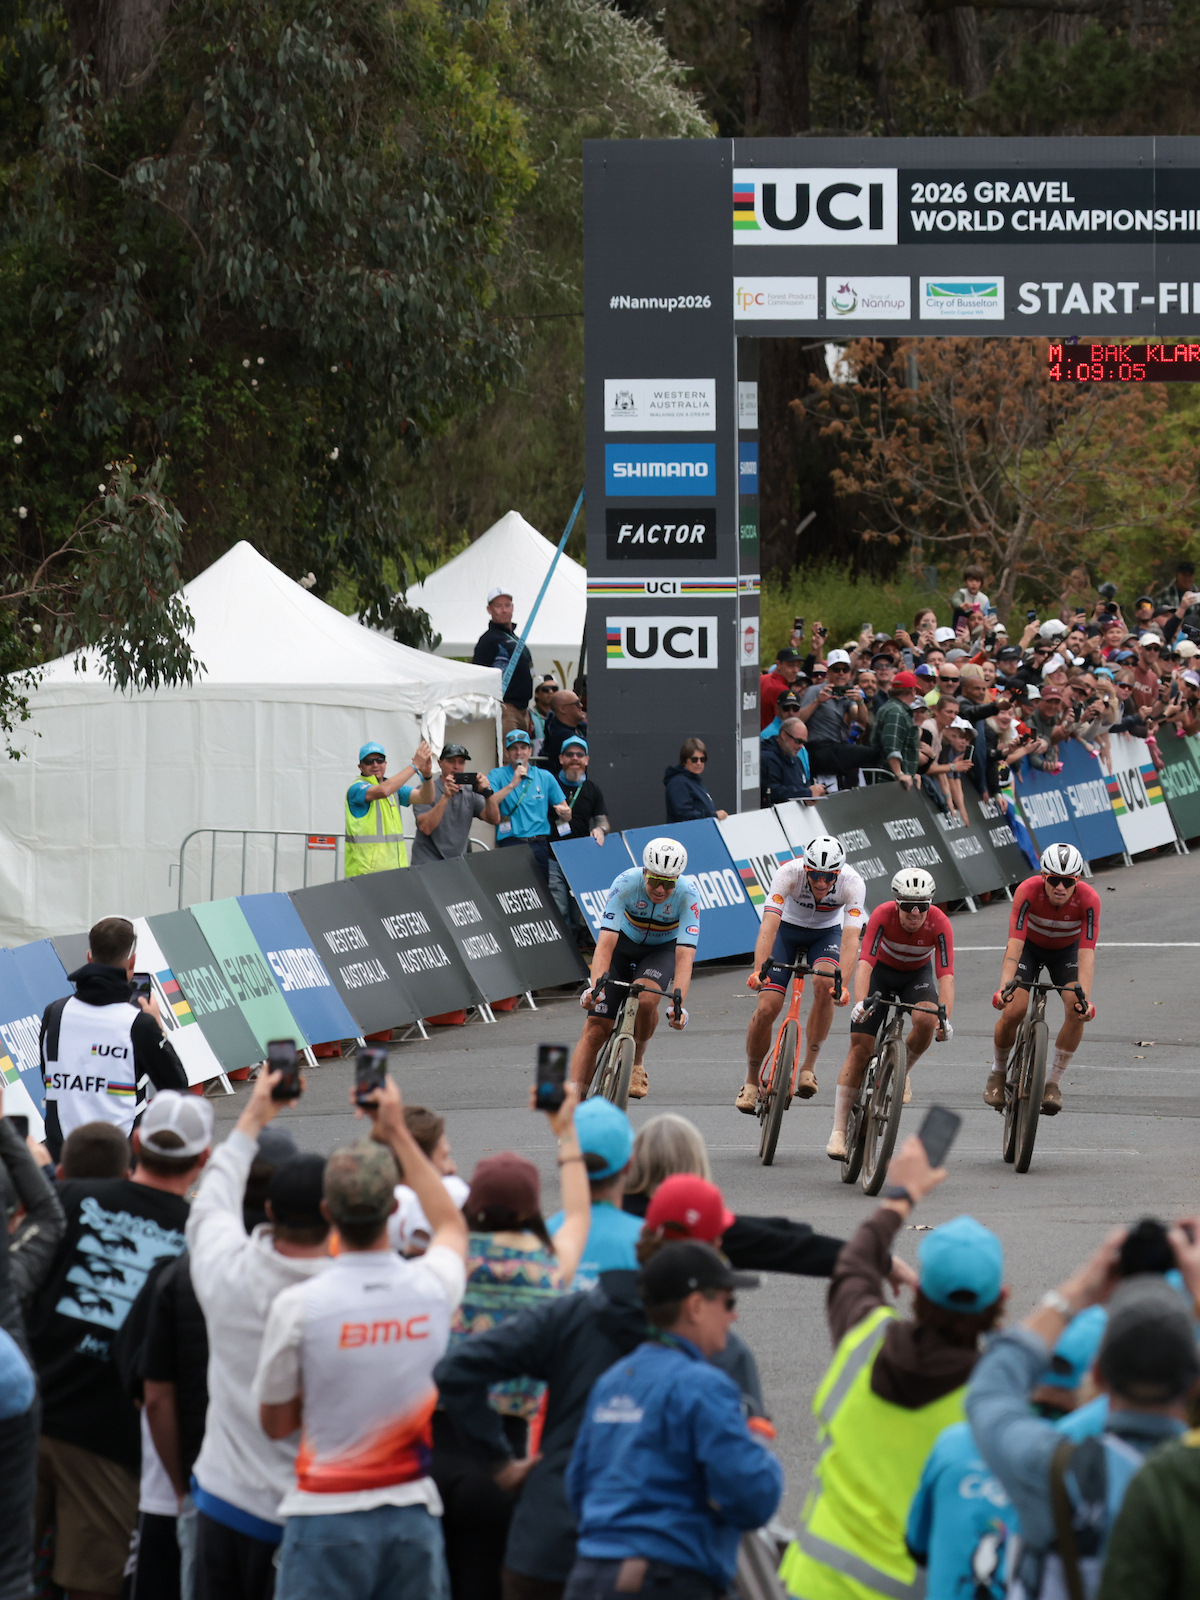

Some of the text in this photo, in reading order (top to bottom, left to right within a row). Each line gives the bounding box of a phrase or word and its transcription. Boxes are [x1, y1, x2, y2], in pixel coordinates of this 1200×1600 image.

[911, 181, 1075, 204] 2026 GRAVEL
[761, 182, 884, 232] UCI
[911, 210, 1004, 232] WORLD
[610, 296, 712, 312] #Nannup2026
[736, 286, 764, 312] fpc
[862, 298, 905, 310] Nannup
[926, 298, 998, 308] City of Busselton
[1091, 345, 1132, 362] BAK
[1049, 363, 1146, 381] 4:09:05
[613, 462, 708, 478] SHIMANO
[617, 524, 706, 544] FACTOR
[647, 582, 676, 594] UCI
[626, 626, 708, 659] UCI
[1066, 778, 1112, 818] SHIMANO
[1116, 767, 1149, 813] UCI
[1020, 789, 1069, 830] SHIMANO
[883, 818, 926, 842] WESTERN
[896, 845, 943, 868] AUSTRALIA
[446, 900, 483, 927] WESTERN
[496, 887, 544, 914] WESTERN
[380, 911, 431, 940] WESTERN
[509, 920, 562, 948] AUSTRALIA
[323, 925, 369, 954] WESTERN
[461, 932, 502, 960] AUSTRALIA
[266, 948, 331, 992] SHIMANO
[396, 944, 451, 974] AUSTRALIA
[338, 958, 390, 990] AUSTRALIA
[98, 1045, 128, 1060] UCI
[52, 1072, 106, 1093] STAFF
[338, 1315, 431, 1350] BMC
